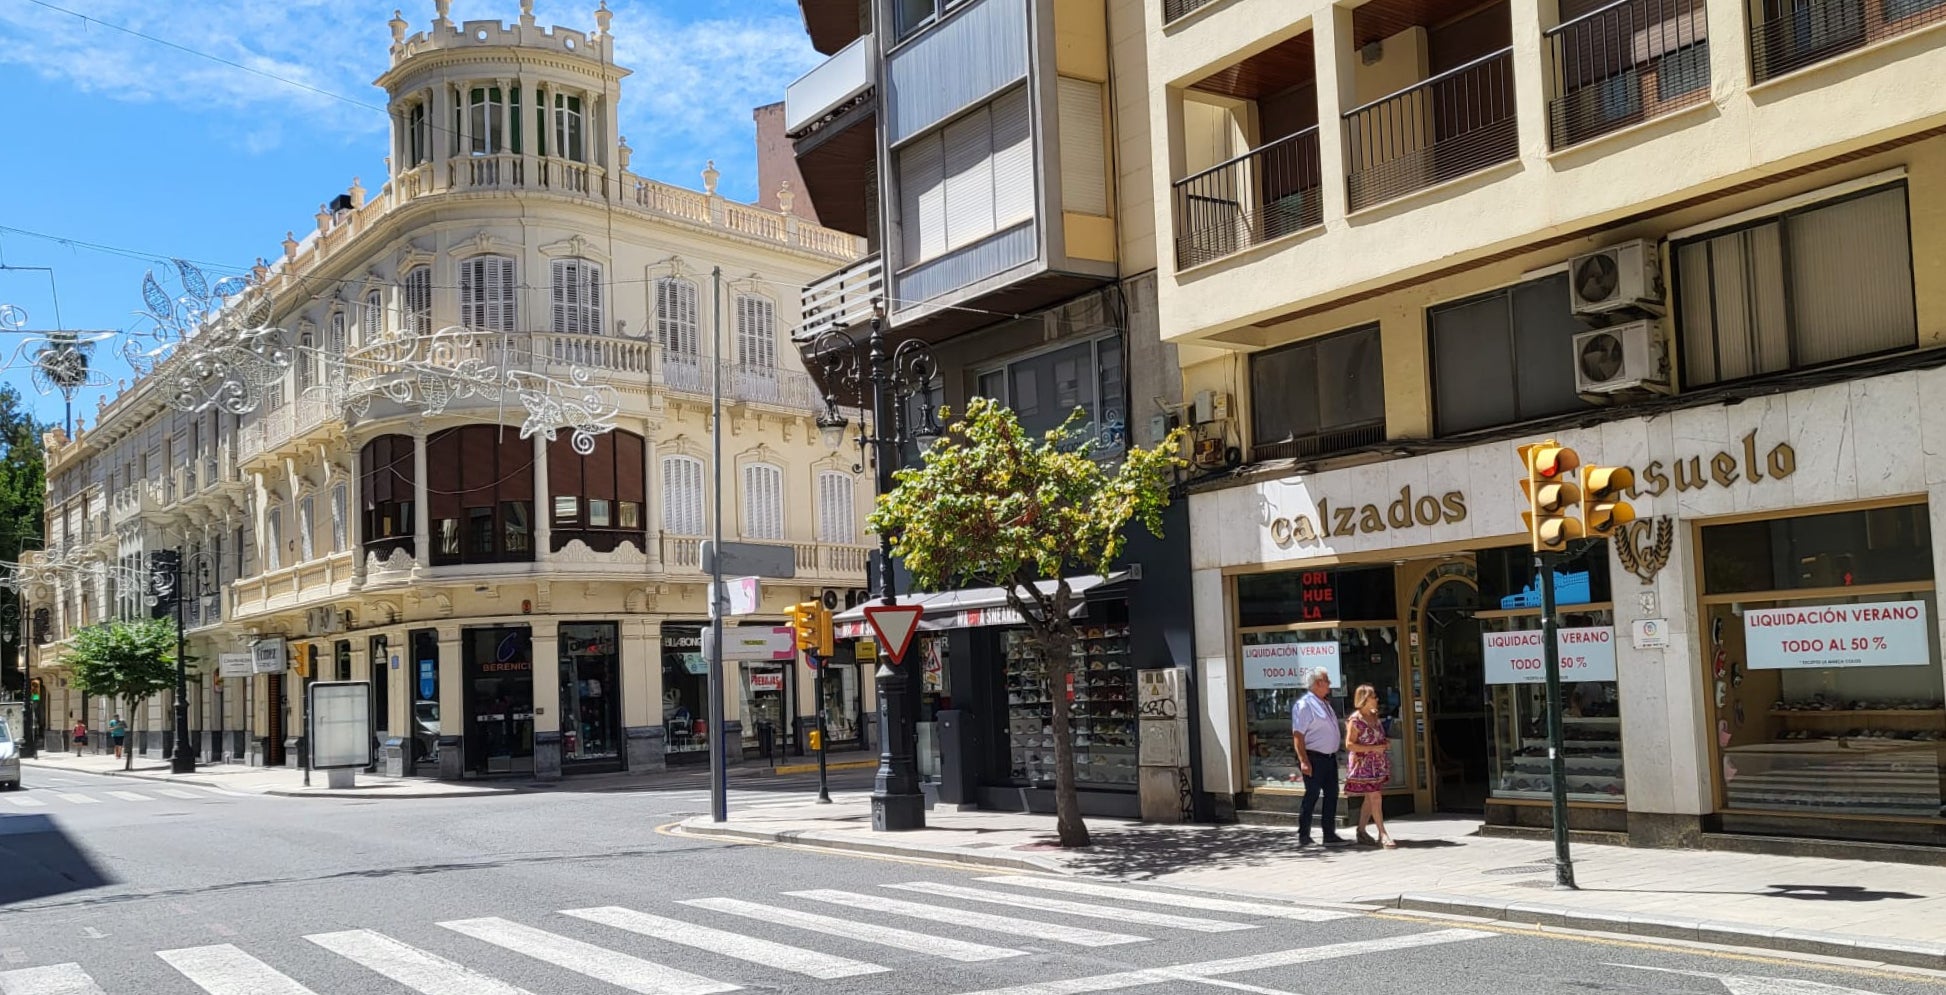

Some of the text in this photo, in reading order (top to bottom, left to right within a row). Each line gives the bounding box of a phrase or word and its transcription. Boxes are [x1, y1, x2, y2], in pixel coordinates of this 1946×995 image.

[1607, 427, 1797, 501] suelo
[1270, 484, 1467, 545] calzados
[1302, 571, 1327, 585] ORI
[1303, 588, 1333, 602] HUE
[986, 607, 1025, 625] SNEAKER
[1303, 605, 1321, 619] LA
[1750, 606, 1918, 627] LIQUIDACIÓN VERANO
[1487, 631, 1609, 648] LIQUIDACI VERANO
[1782, 636, 1887, 653] TODO AL 50 %
[1246, 644, 1335, 658] LIQUIDACIÓN VERANO
[1510, 656, 1587, 670] TODO 50 %
[1263, 668, 1285, 678] TODO
[1287, 668, 1297, 677] AL
